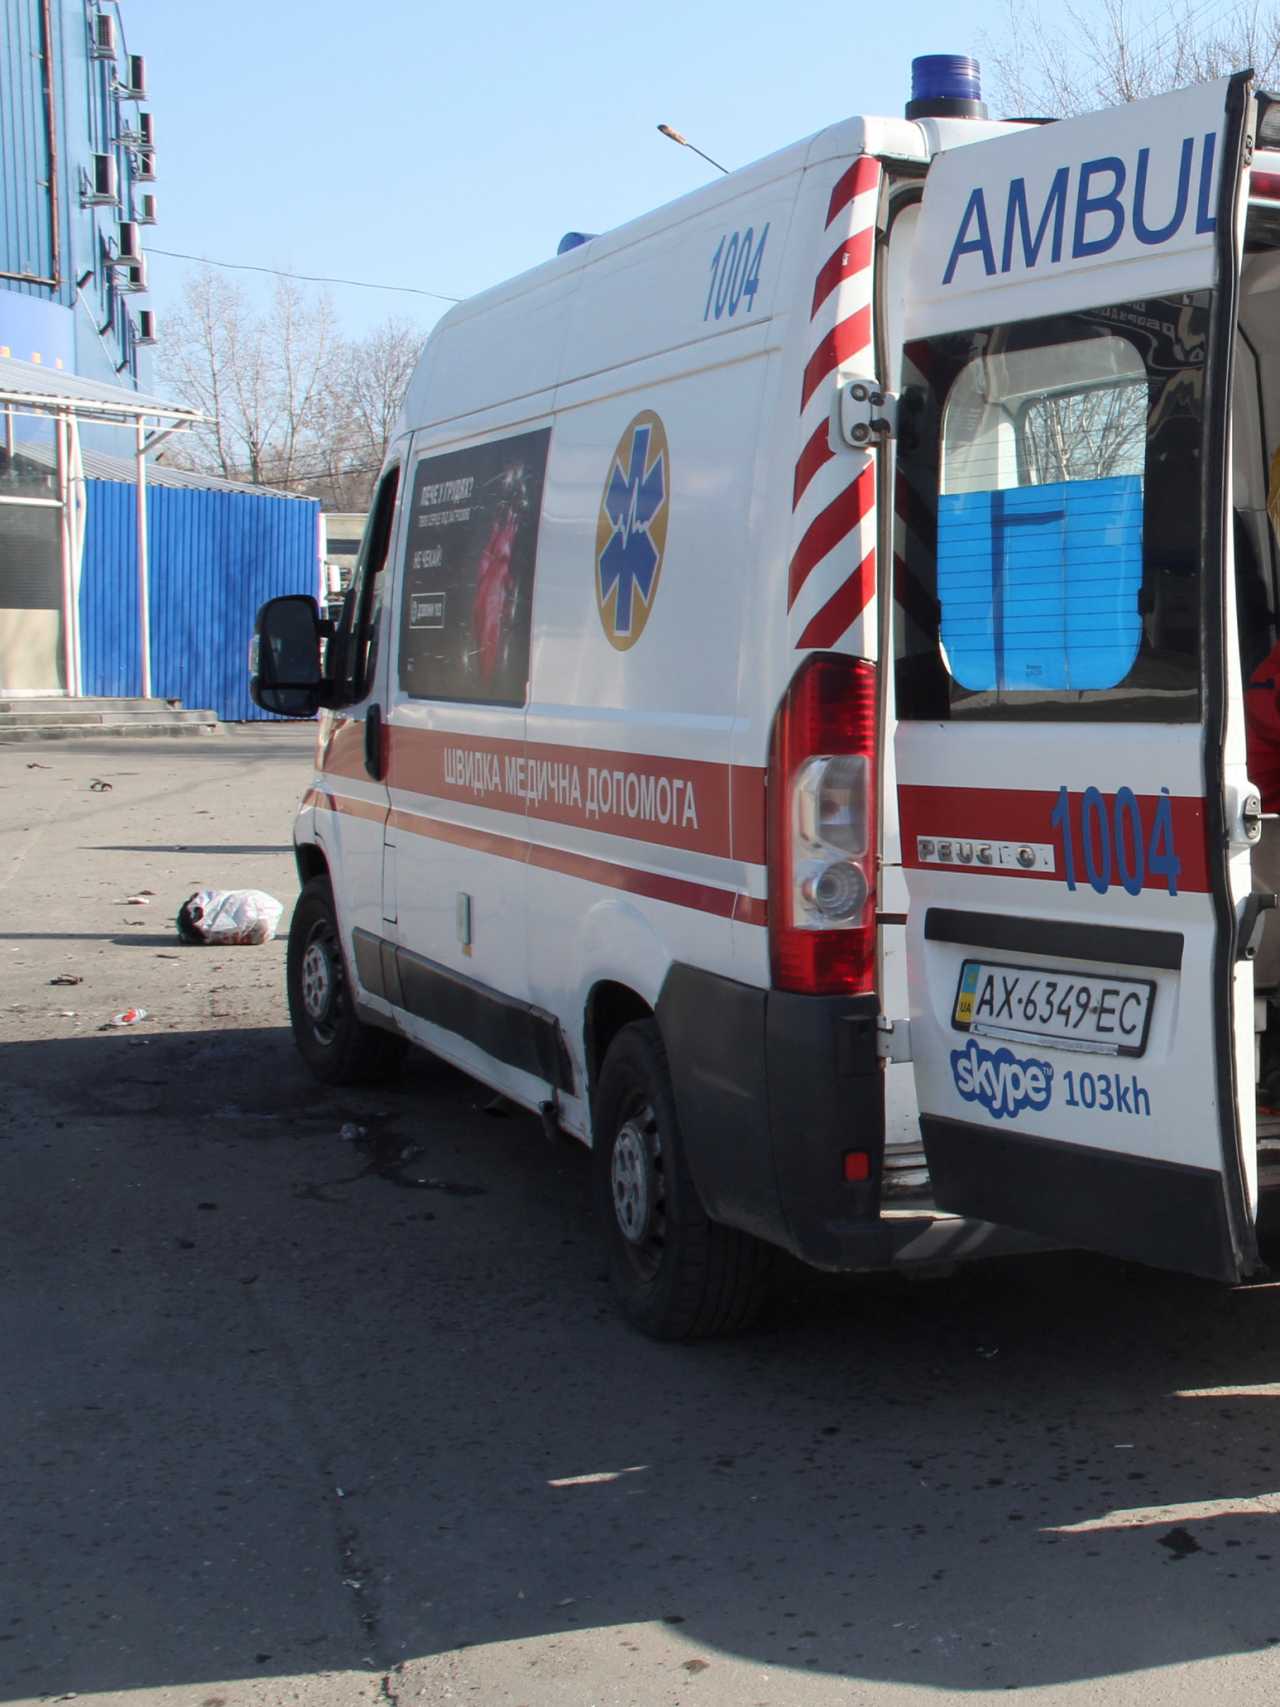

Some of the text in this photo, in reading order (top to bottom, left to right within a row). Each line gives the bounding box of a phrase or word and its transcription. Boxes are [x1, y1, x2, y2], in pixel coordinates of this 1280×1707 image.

[942, 132, 1217, 285] AMBUL
[704, 222, 770, 321] 1004
[444, 748, 698, 829] ШВИДКА МЕДИЧНА ДОПОМОГА
[1051, 786, 1181, 896] 1004
[957, 1047, 1047, 1112] skype
[1063, 1070, 1151, 1116] 103kh
